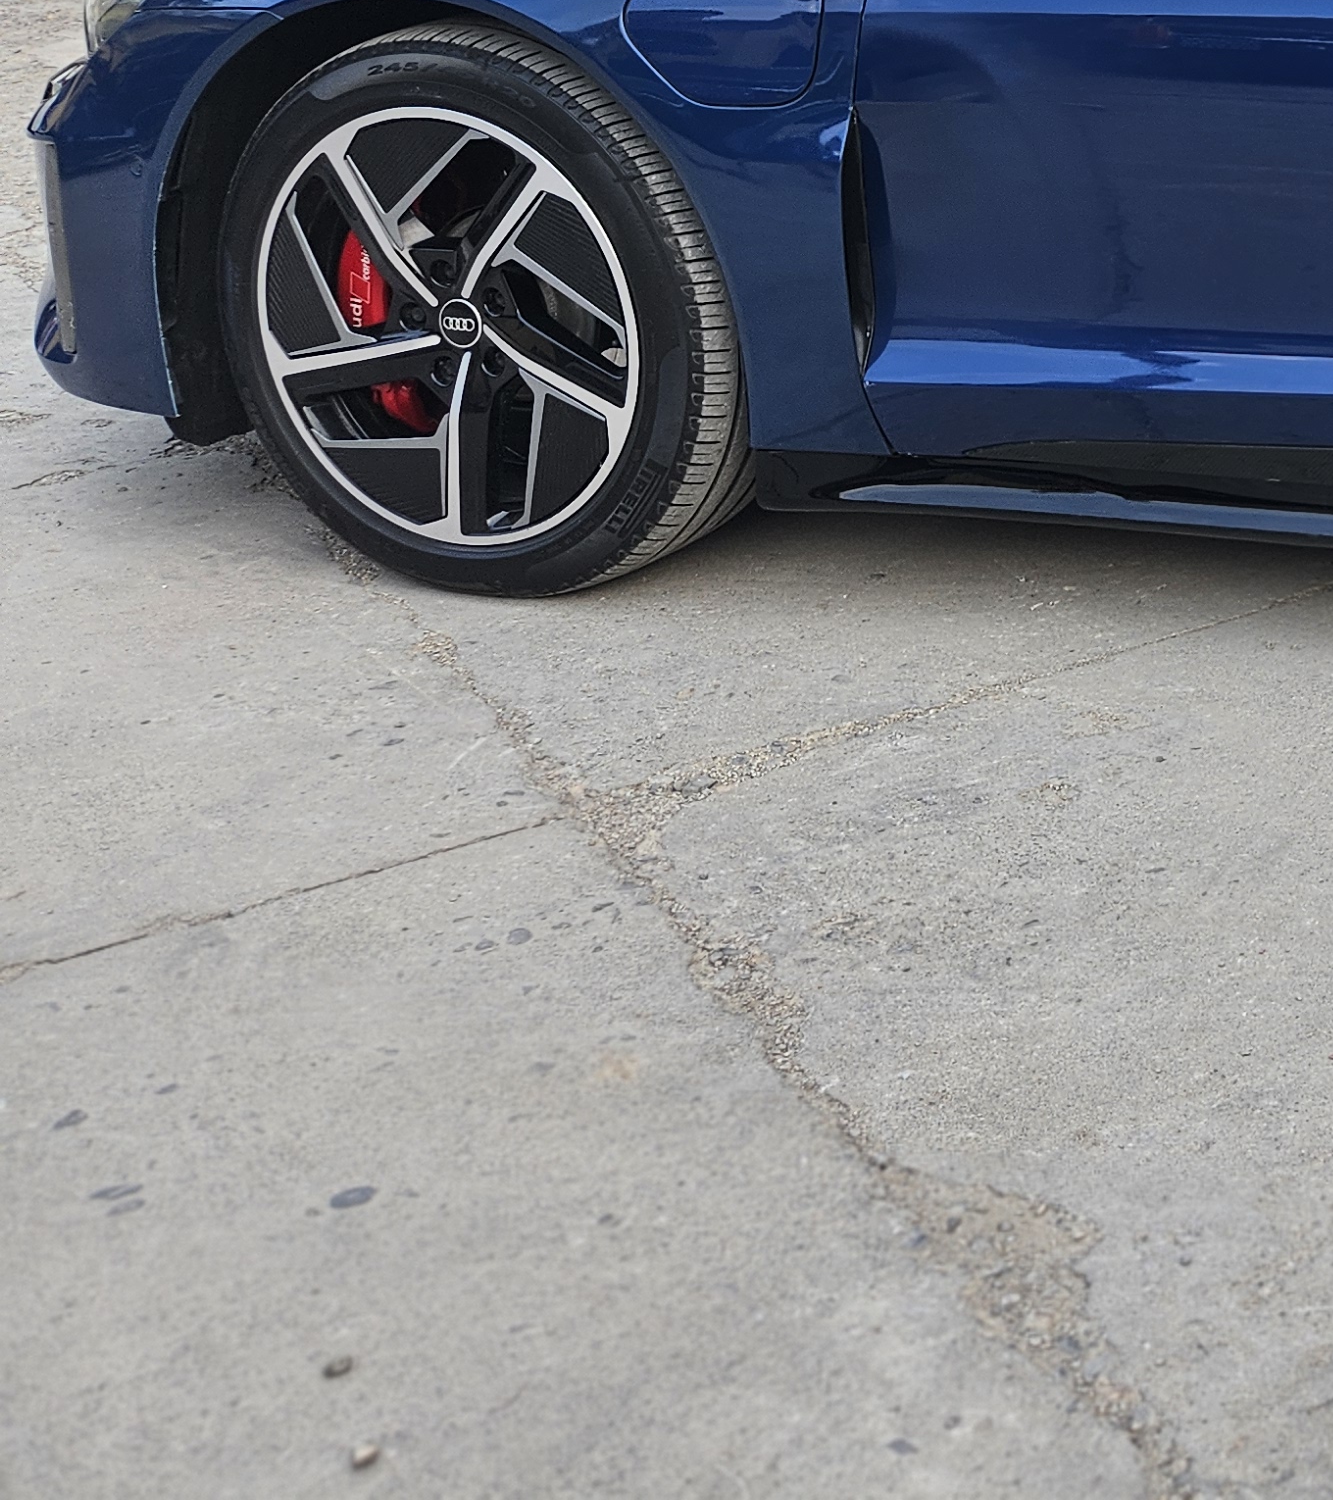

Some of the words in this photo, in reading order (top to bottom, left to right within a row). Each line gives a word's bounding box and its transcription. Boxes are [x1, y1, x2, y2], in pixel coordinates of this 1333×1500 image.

[349, 297, 363, 328] udi
[361, 245, 371, 281] carbi
[604, 458, 668, 538] PIRELLI
